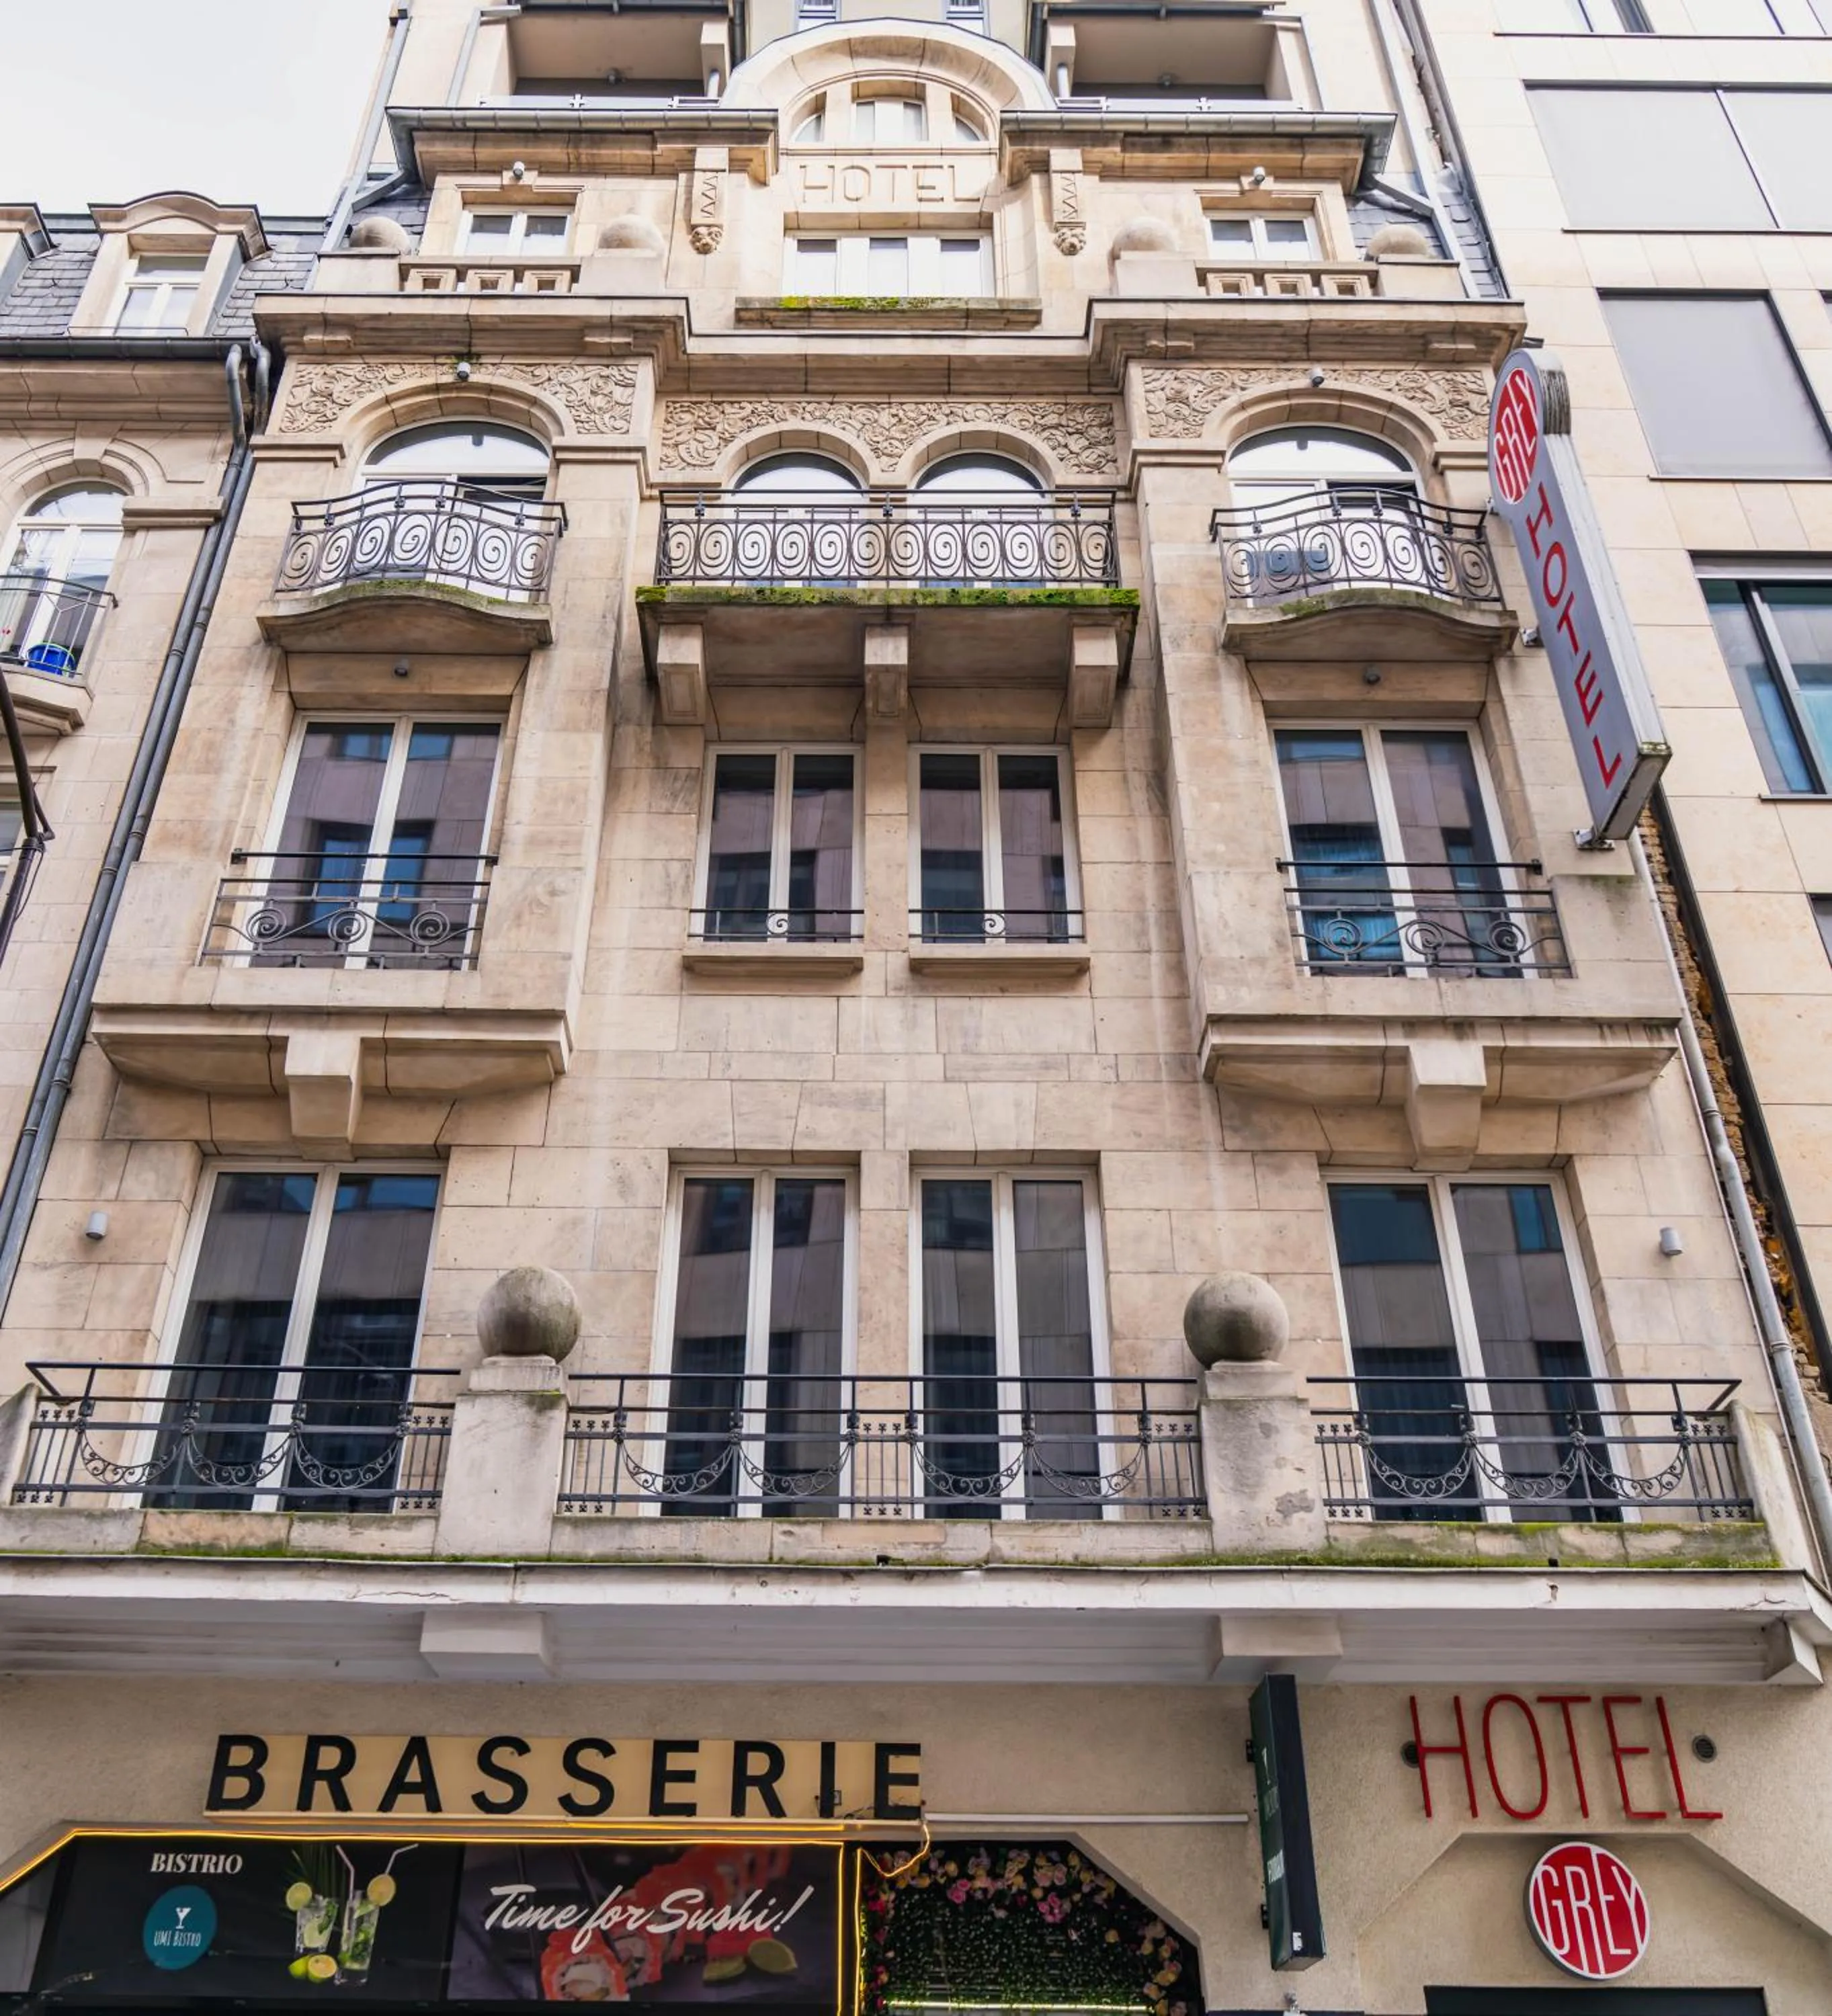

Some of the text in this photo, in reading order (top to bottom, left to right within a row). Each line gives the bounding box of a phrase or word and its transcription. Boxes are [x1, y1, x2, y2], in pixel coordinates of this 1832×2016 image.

[799, 164, 981, 204] HOTEL
[1493, 368, 1539, 504] GREY
[1525, 481, 1622, 790] HOTEL
[206, 1734, 922, 1820] BRASSERIE
[1409, 1693, 1724, 1820] HOTEL
[150, 1852, 243, 1874] BISTRIO
[1534, 1847, 1647, 1976] GREY
[483, 1884, 815, 1954] Time for Sushi!
